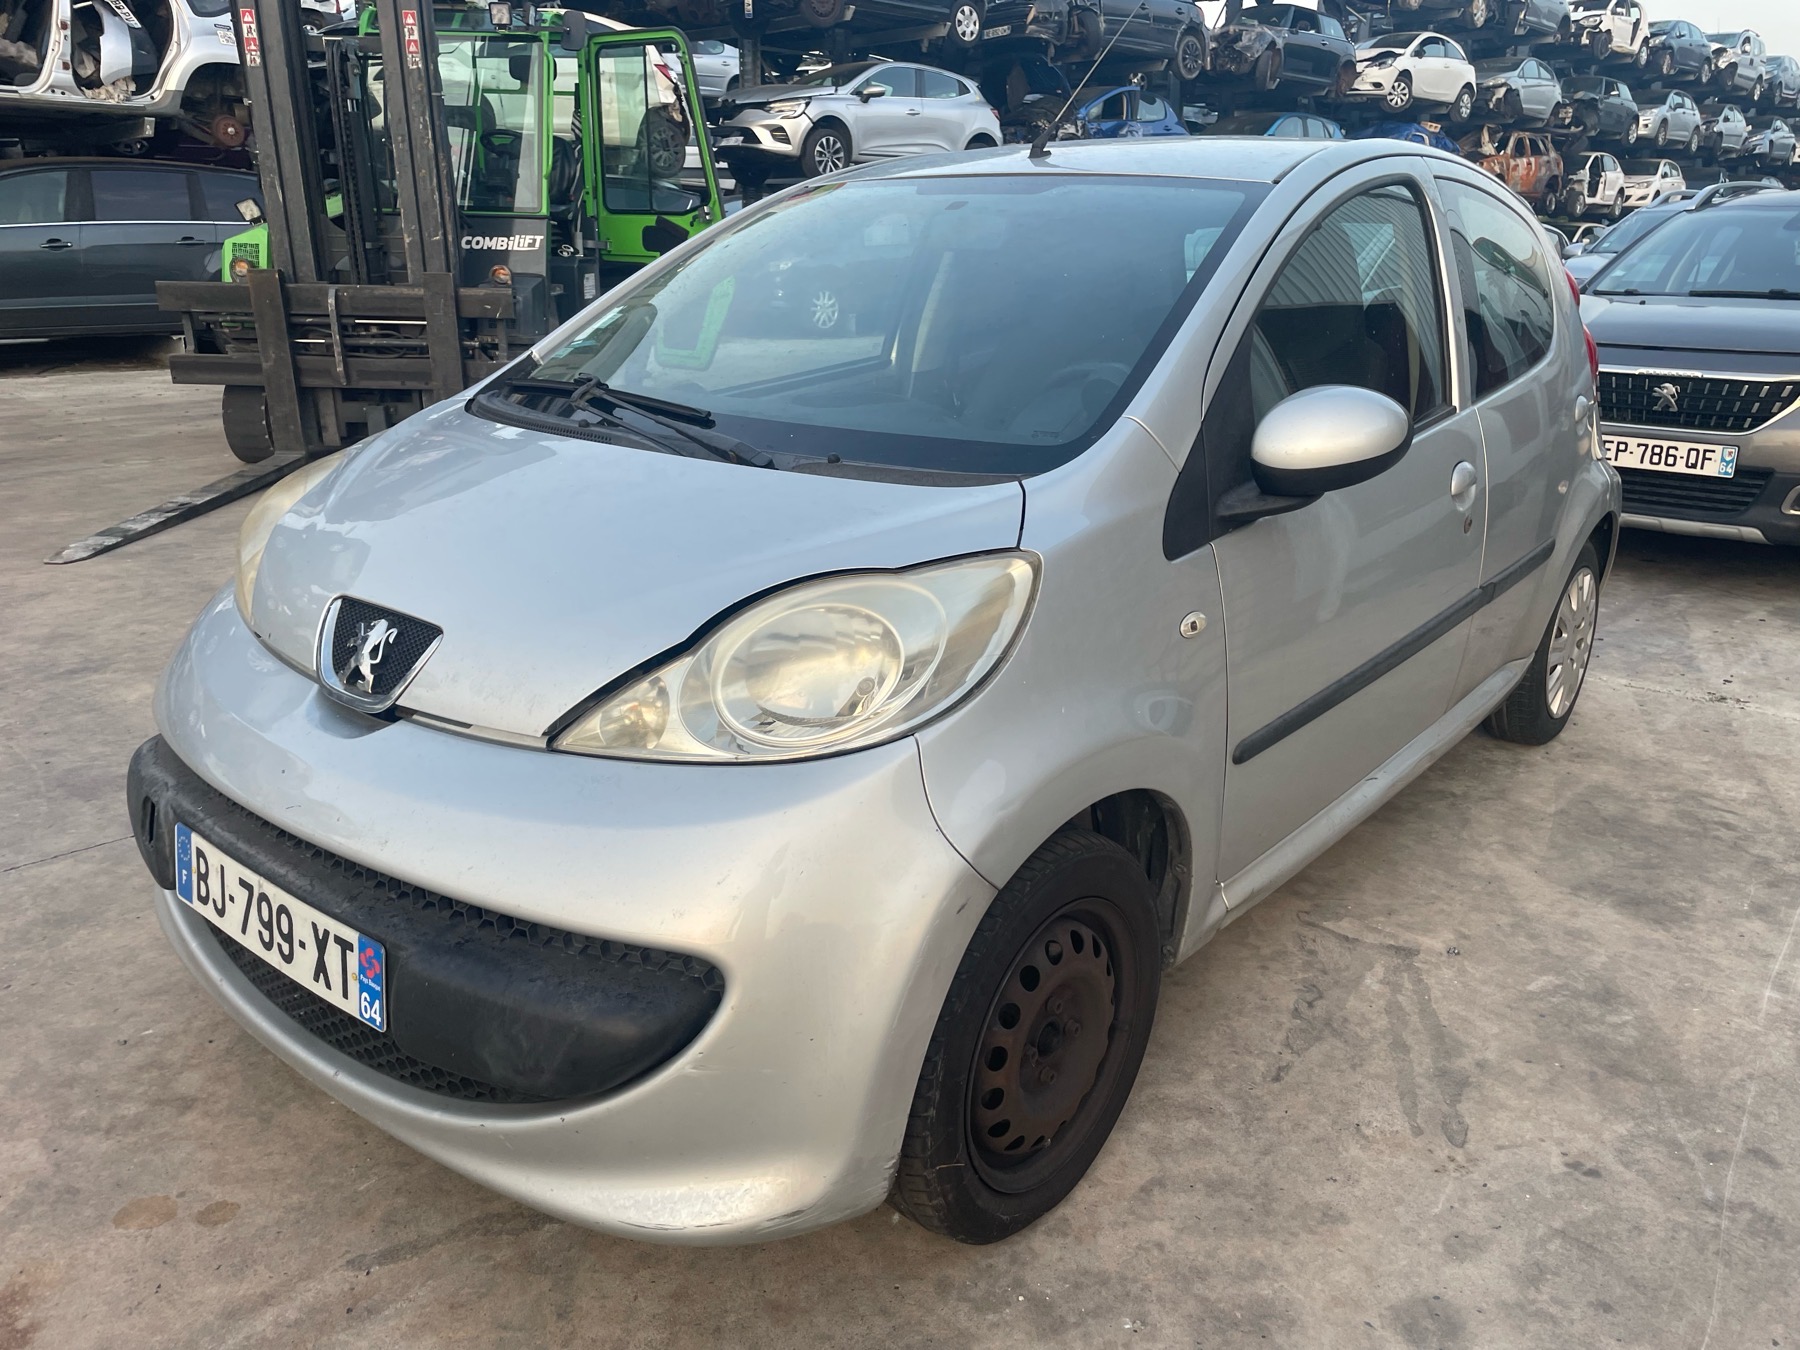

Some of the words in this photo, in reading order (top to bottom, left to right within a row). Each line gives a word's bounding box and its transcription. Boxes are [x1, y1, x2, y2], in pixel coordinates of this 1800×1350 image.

[1603, 440, 1716, 470] EP-786-QF
[1719, 461, 1733, 474] 64
[182, 869, 188, 885] F
[195, 846, 354, 1000] BJ-799-XT
[360, 992, 382, 1026] 64
